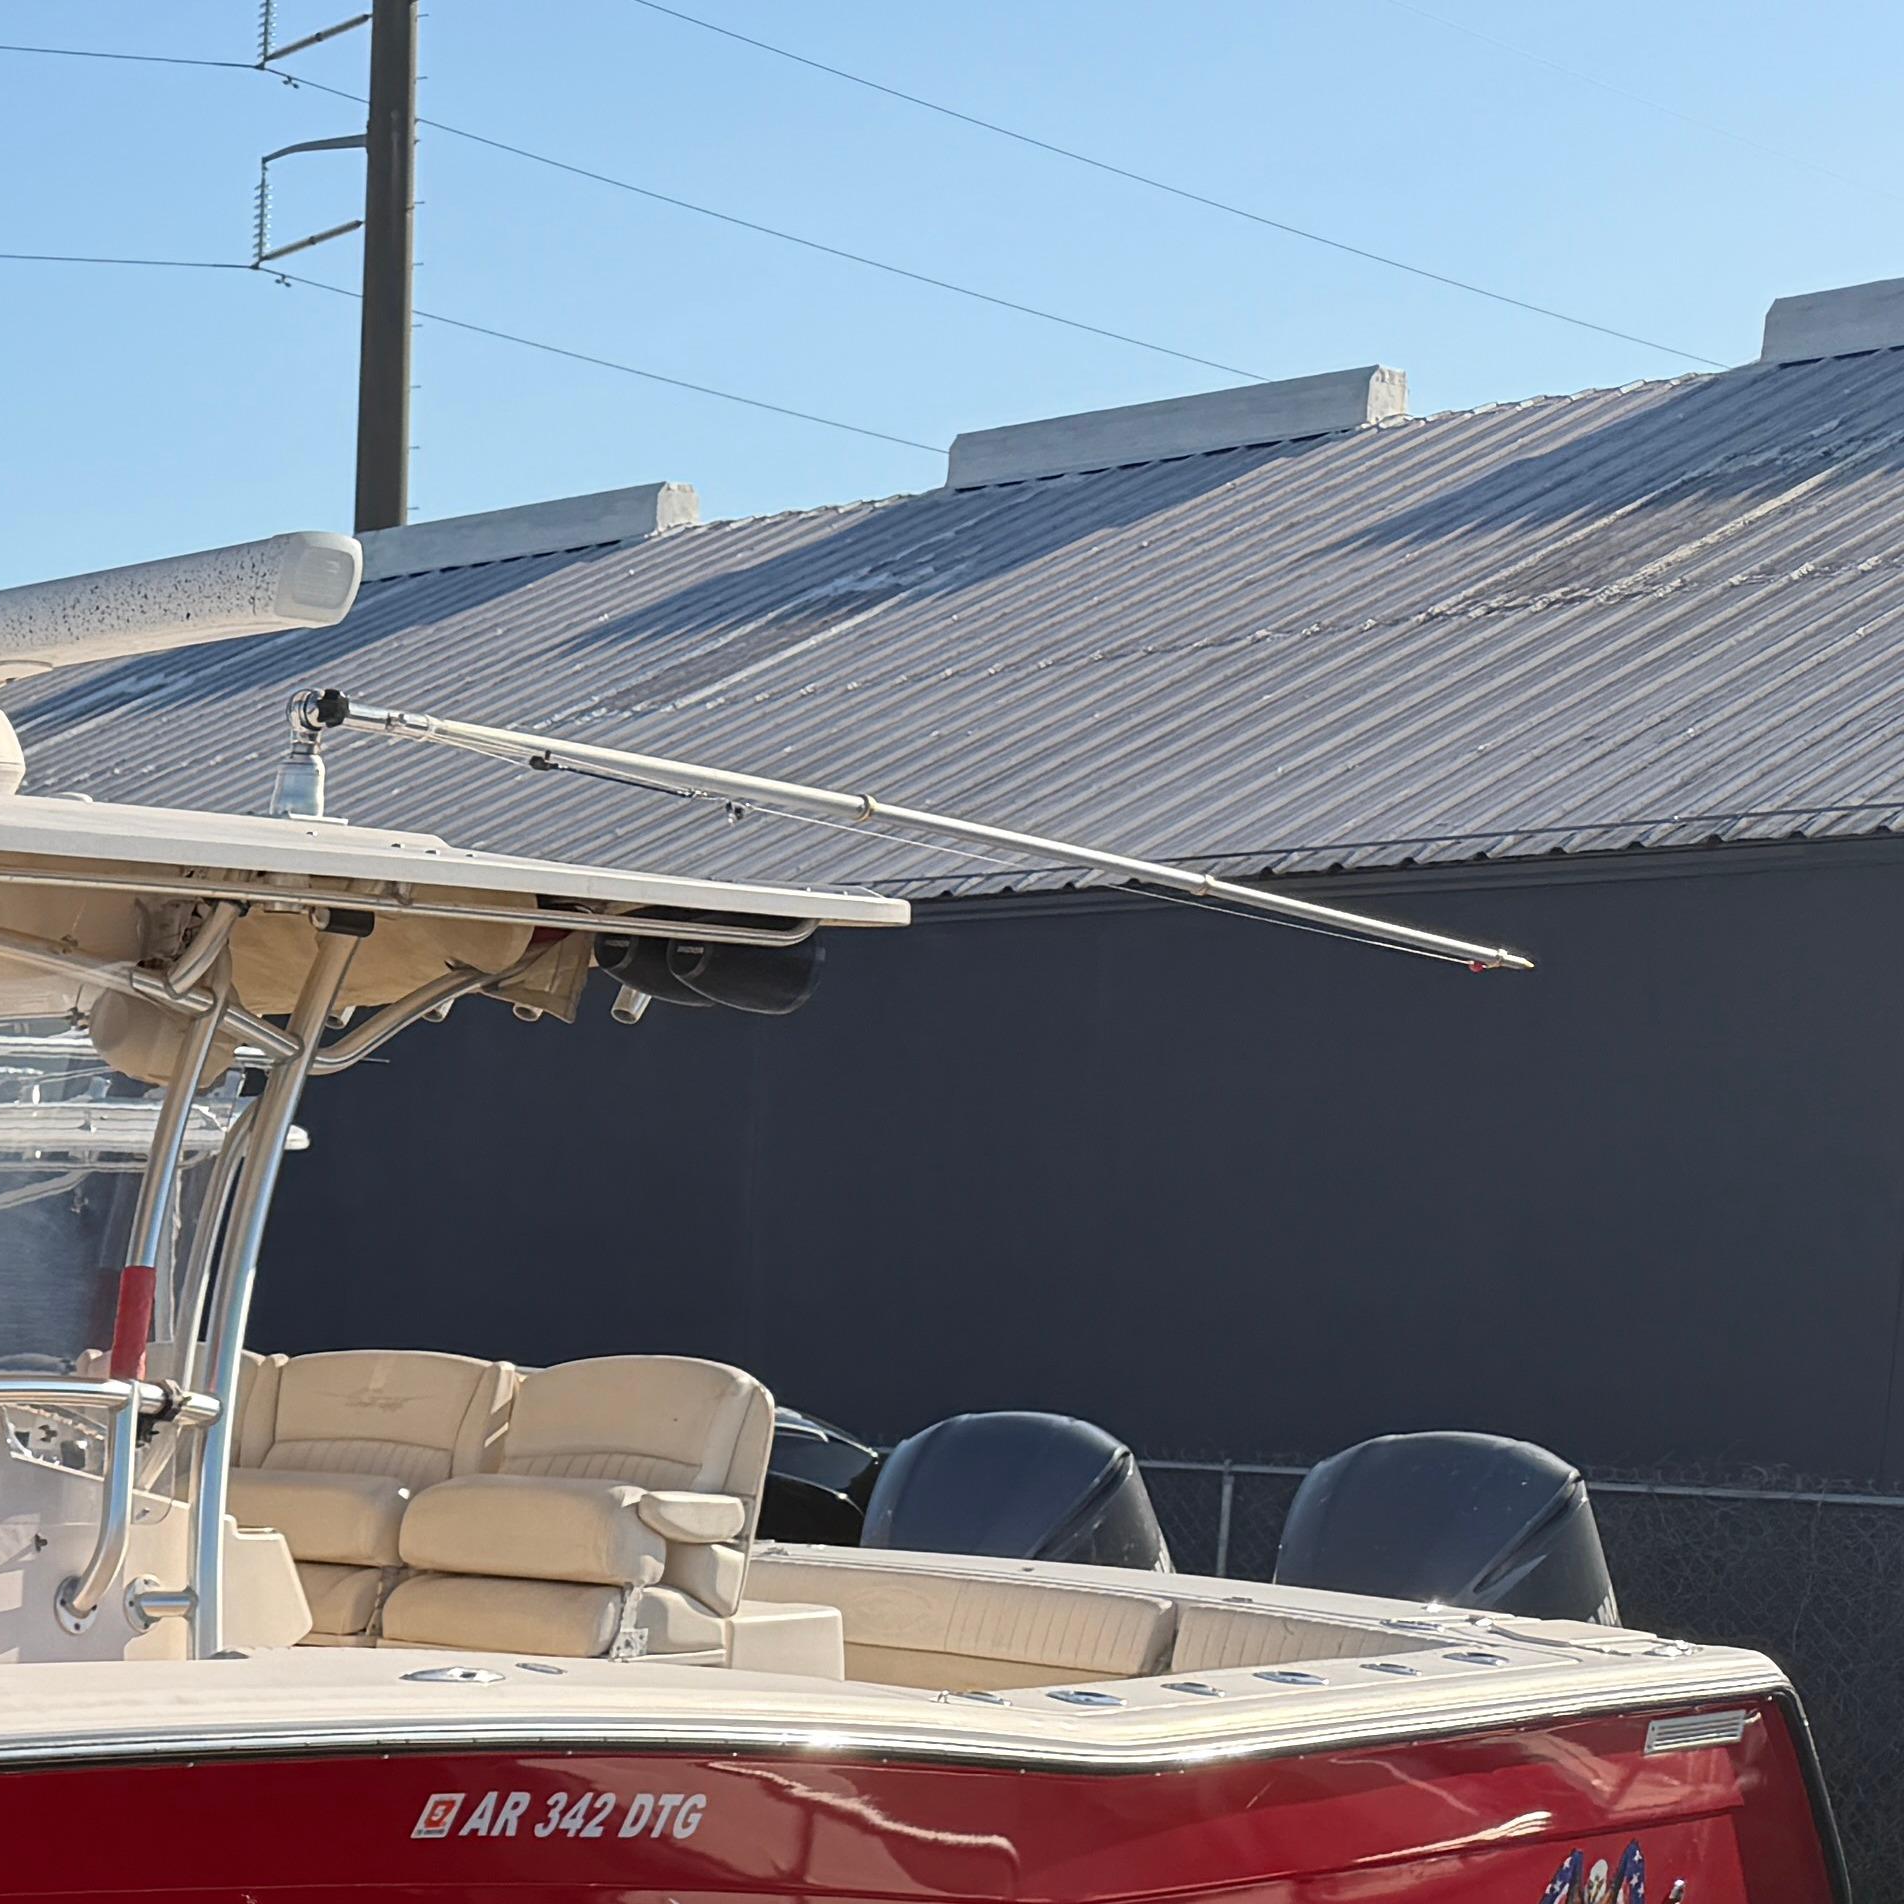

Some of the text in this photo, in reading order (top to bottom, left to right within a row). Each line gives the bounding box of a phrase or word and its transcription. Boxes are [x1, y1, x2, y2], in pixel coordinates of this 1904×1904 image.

[457, 1791, 708, 1840] AR 342 DTG
